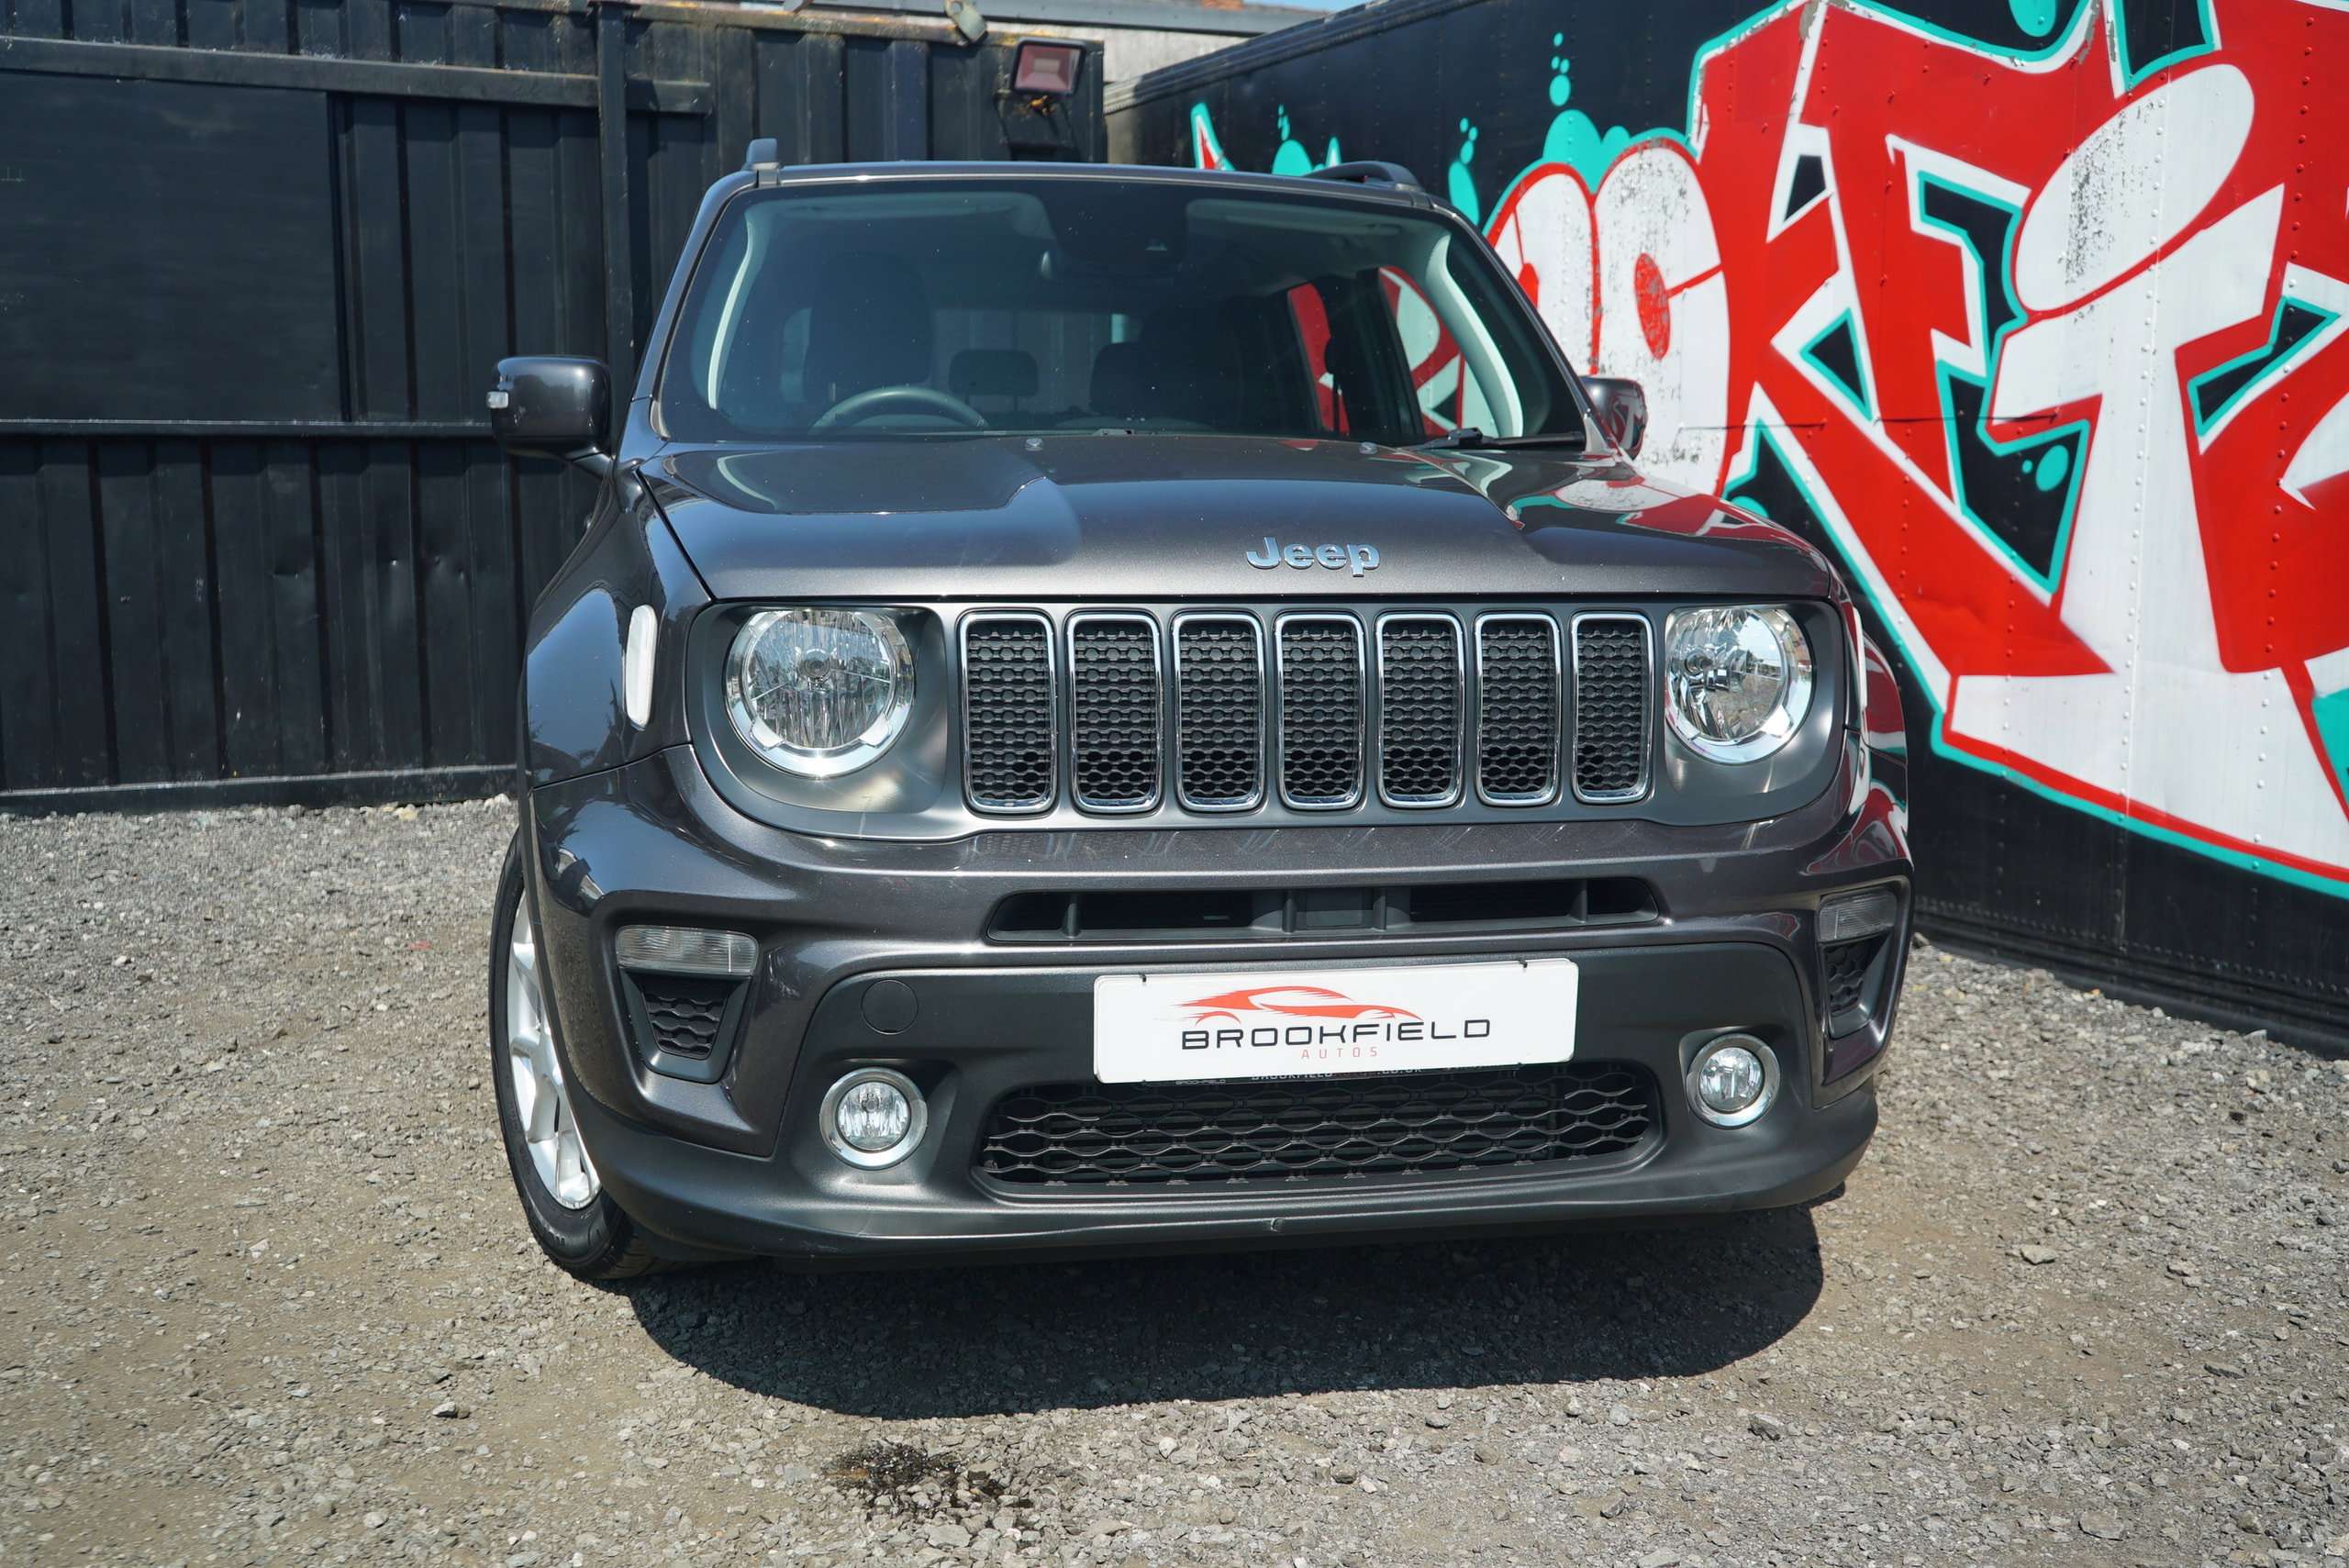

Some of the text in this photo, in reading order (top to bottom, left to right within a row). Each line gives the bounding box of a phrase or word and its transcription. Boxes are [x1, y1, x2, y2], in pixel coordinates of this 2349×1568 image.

[1246, 536, 1380, 577] Jeep
[1181, 1018, 1490, 1050] BROOKFIELD
[1301, 1046, 1378, 1059] AUTOS
